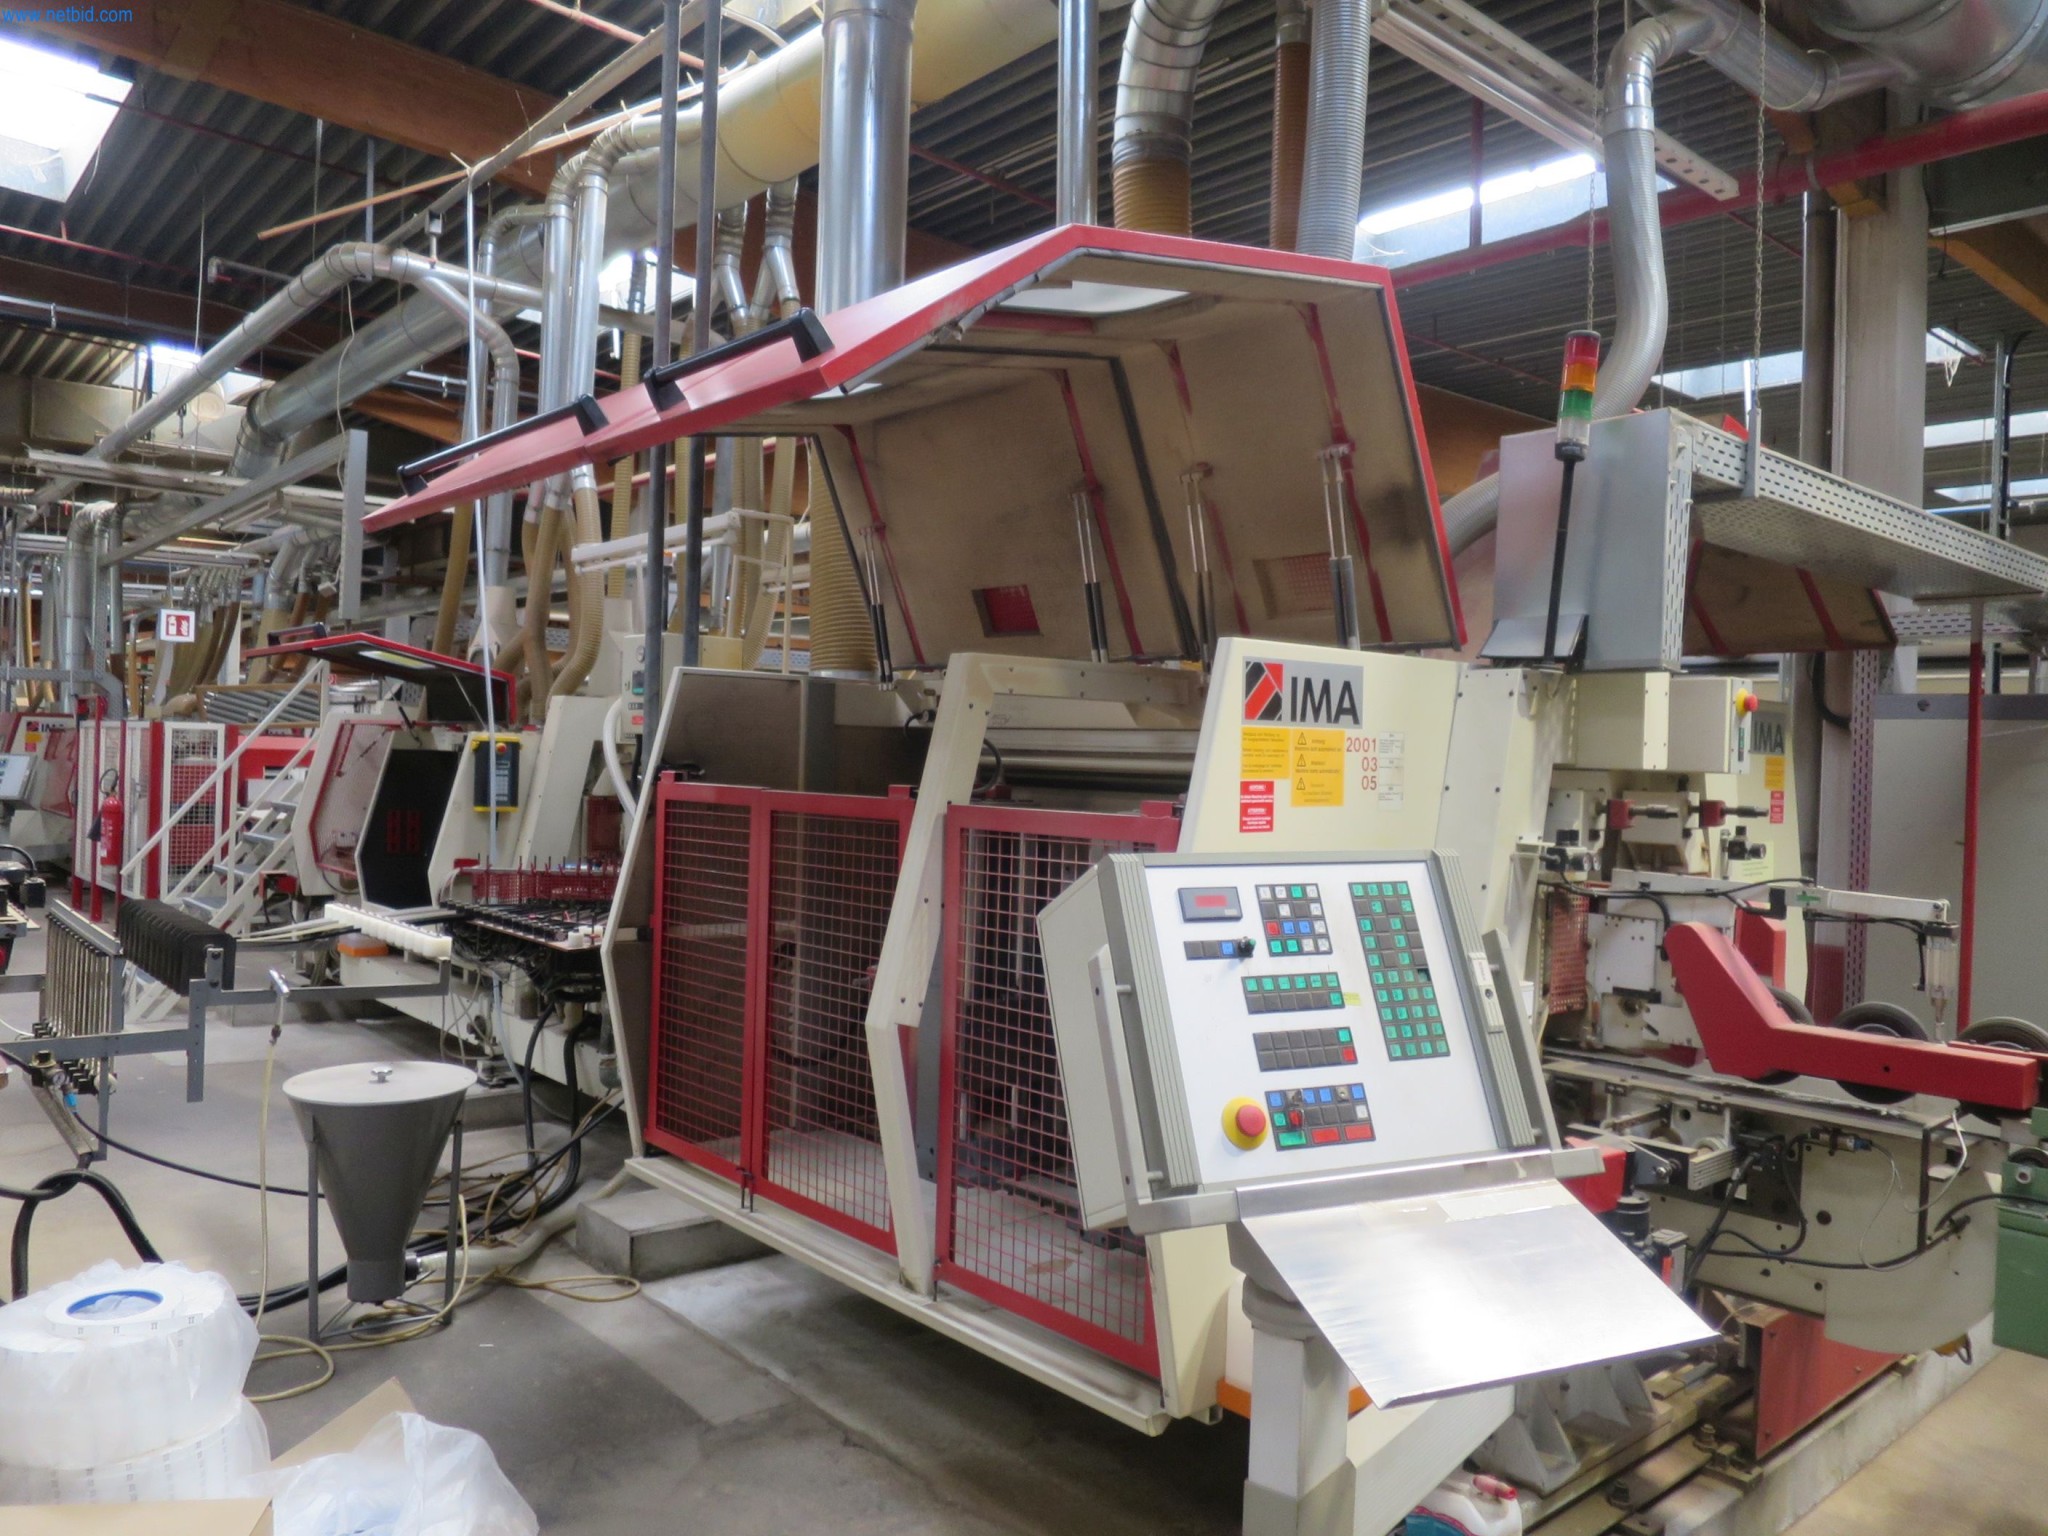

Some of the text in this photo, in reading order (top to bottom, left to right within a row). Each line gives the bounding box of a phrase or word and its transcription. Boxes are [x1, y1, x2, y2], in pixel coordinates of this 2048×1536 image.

[1290, 676, 1360, 725] IMA
[1346, 736, 1377, 753] 2001
[1754, 720, 1785, 755] IMA
[1361, 756, 1378, 773] 03
[1361, 775, 1378, 791] 05
